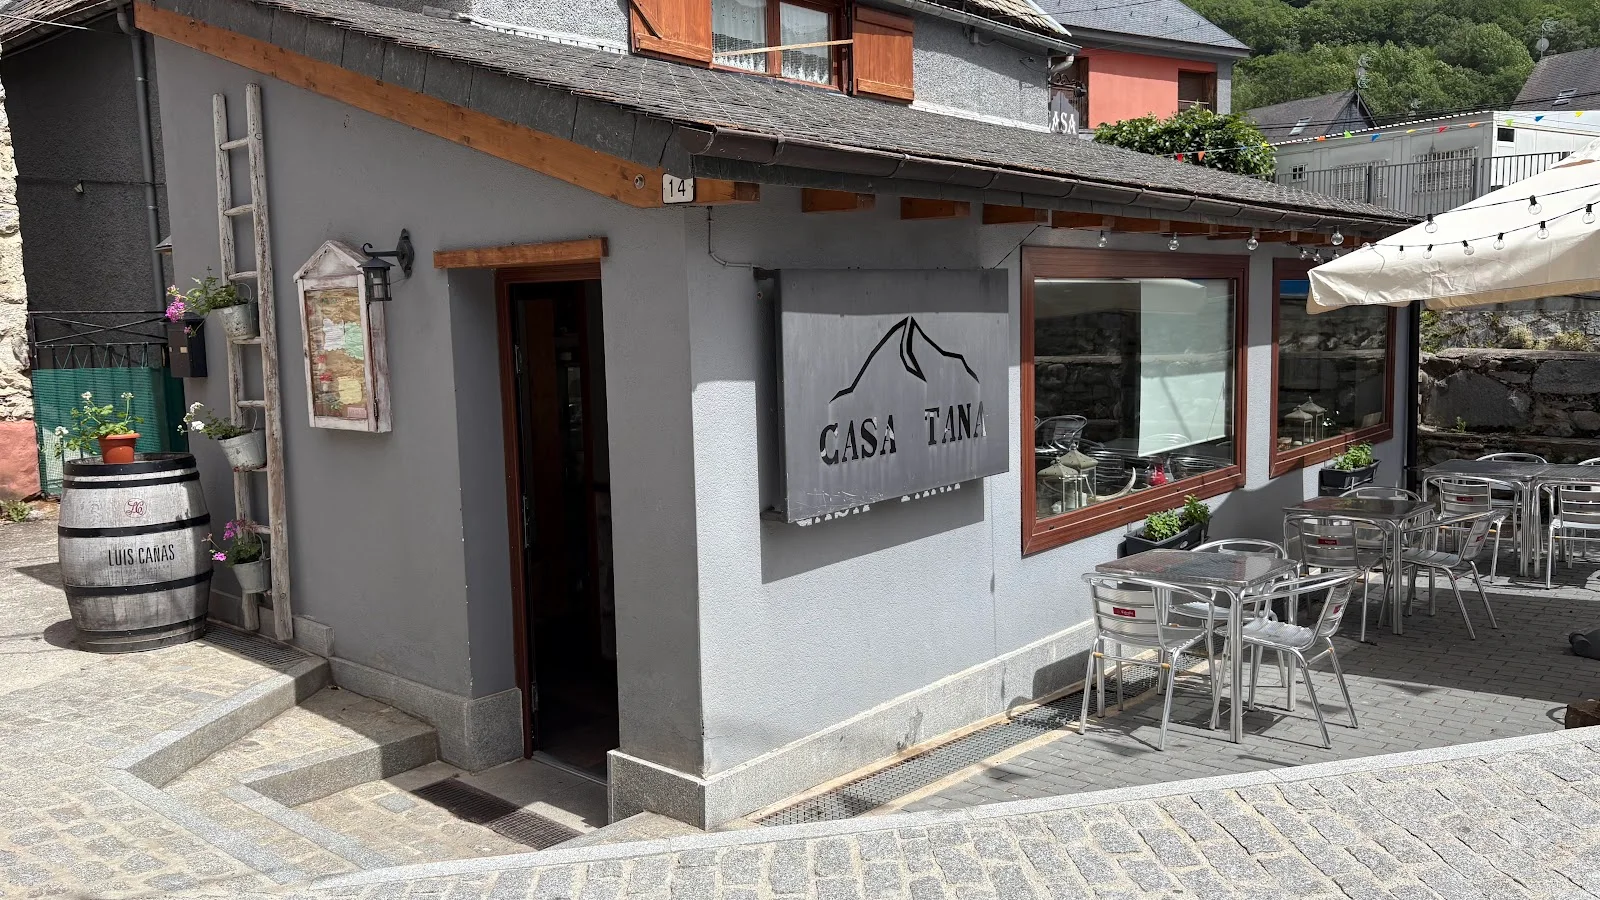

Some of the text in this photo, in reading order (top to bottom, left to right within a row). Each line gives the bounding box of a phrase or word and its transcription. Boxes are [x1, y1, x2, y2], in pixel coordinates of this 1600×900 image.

[1048, 111, 1077, 135] ASA
[669, 179, 686, 197] 14
[819, 400, 987, 466] CASA TANA
[108, 543, 175, 567] LUIS CAÑAS
